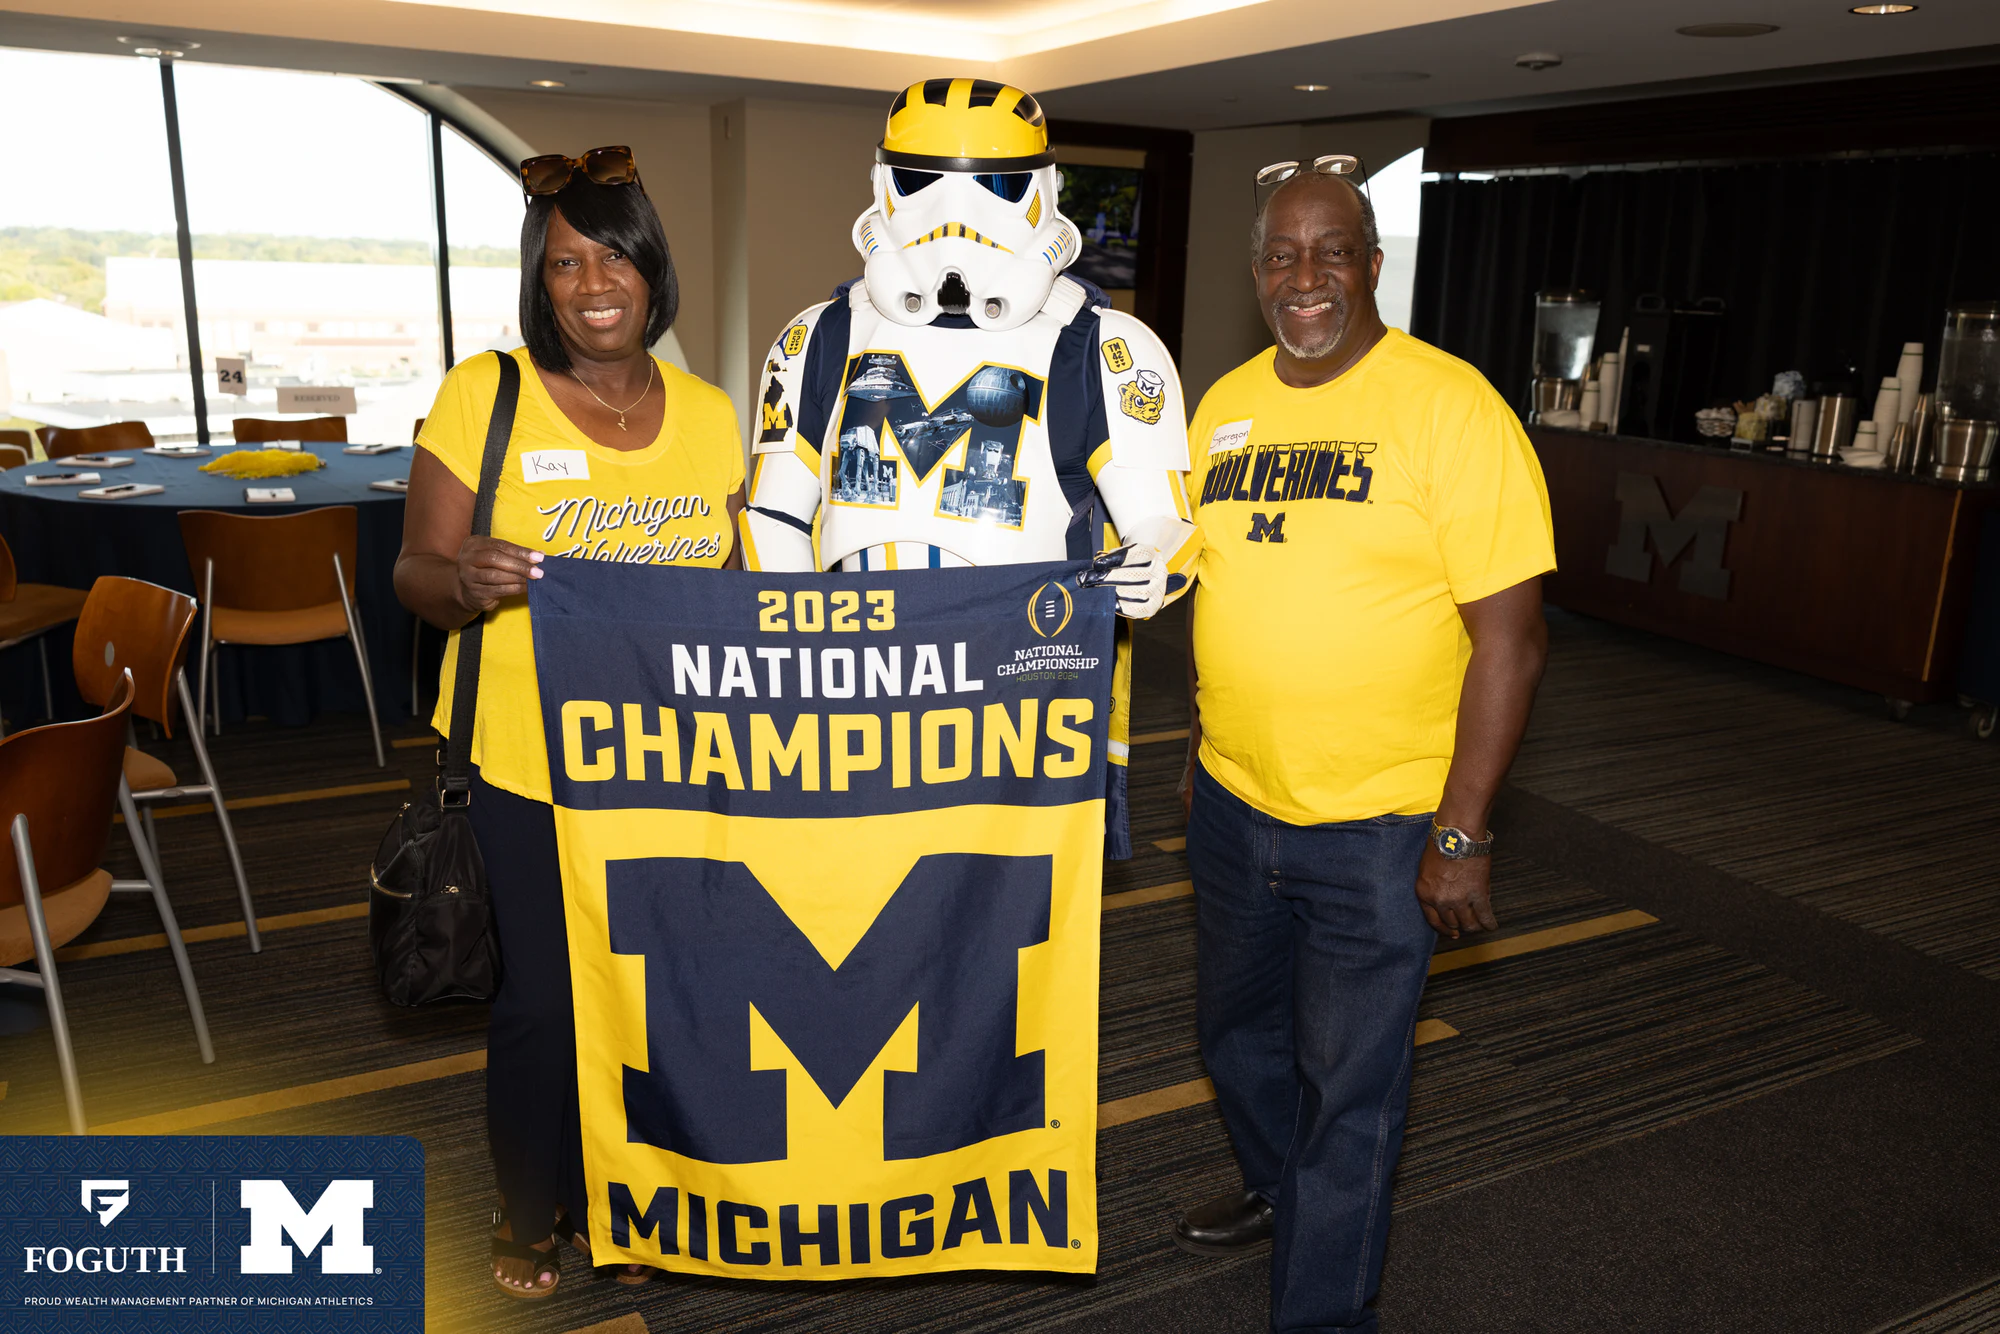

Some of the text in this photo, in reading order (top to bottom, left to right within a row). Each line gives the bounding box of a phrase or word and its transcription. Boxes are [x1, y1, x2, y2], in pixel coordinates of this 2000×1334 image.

[1112, 350, 1124, 361] 42
[220, 370, 243, 384] 24
[1140, 380, 1155, 395] M
[763, 402, 788, 430] M
[532, 455, 569, 476] Kay
[1200, 440, 1377, 507] WOLVERINES
[537, 494, 710, 543] Michigan
[1246, 512, 1286, 543] M
[1605, 473, 1747, 600] M
[757, 590, 896, 633] 2023
[997, 658, 1099, 677] CHAMPIONSHIP
[1014, 645, 1083, 661] NATIONAL
[672, 642, 984, 698] NATIONAL
[1016, 671, 1078, 682] HOUSTON 2024
[561, 698, 1094, 791] CHAMPIONS
[605, 852, 1053, 1164] M
[607, 1169, 1068, 1266] MICHIGAN
